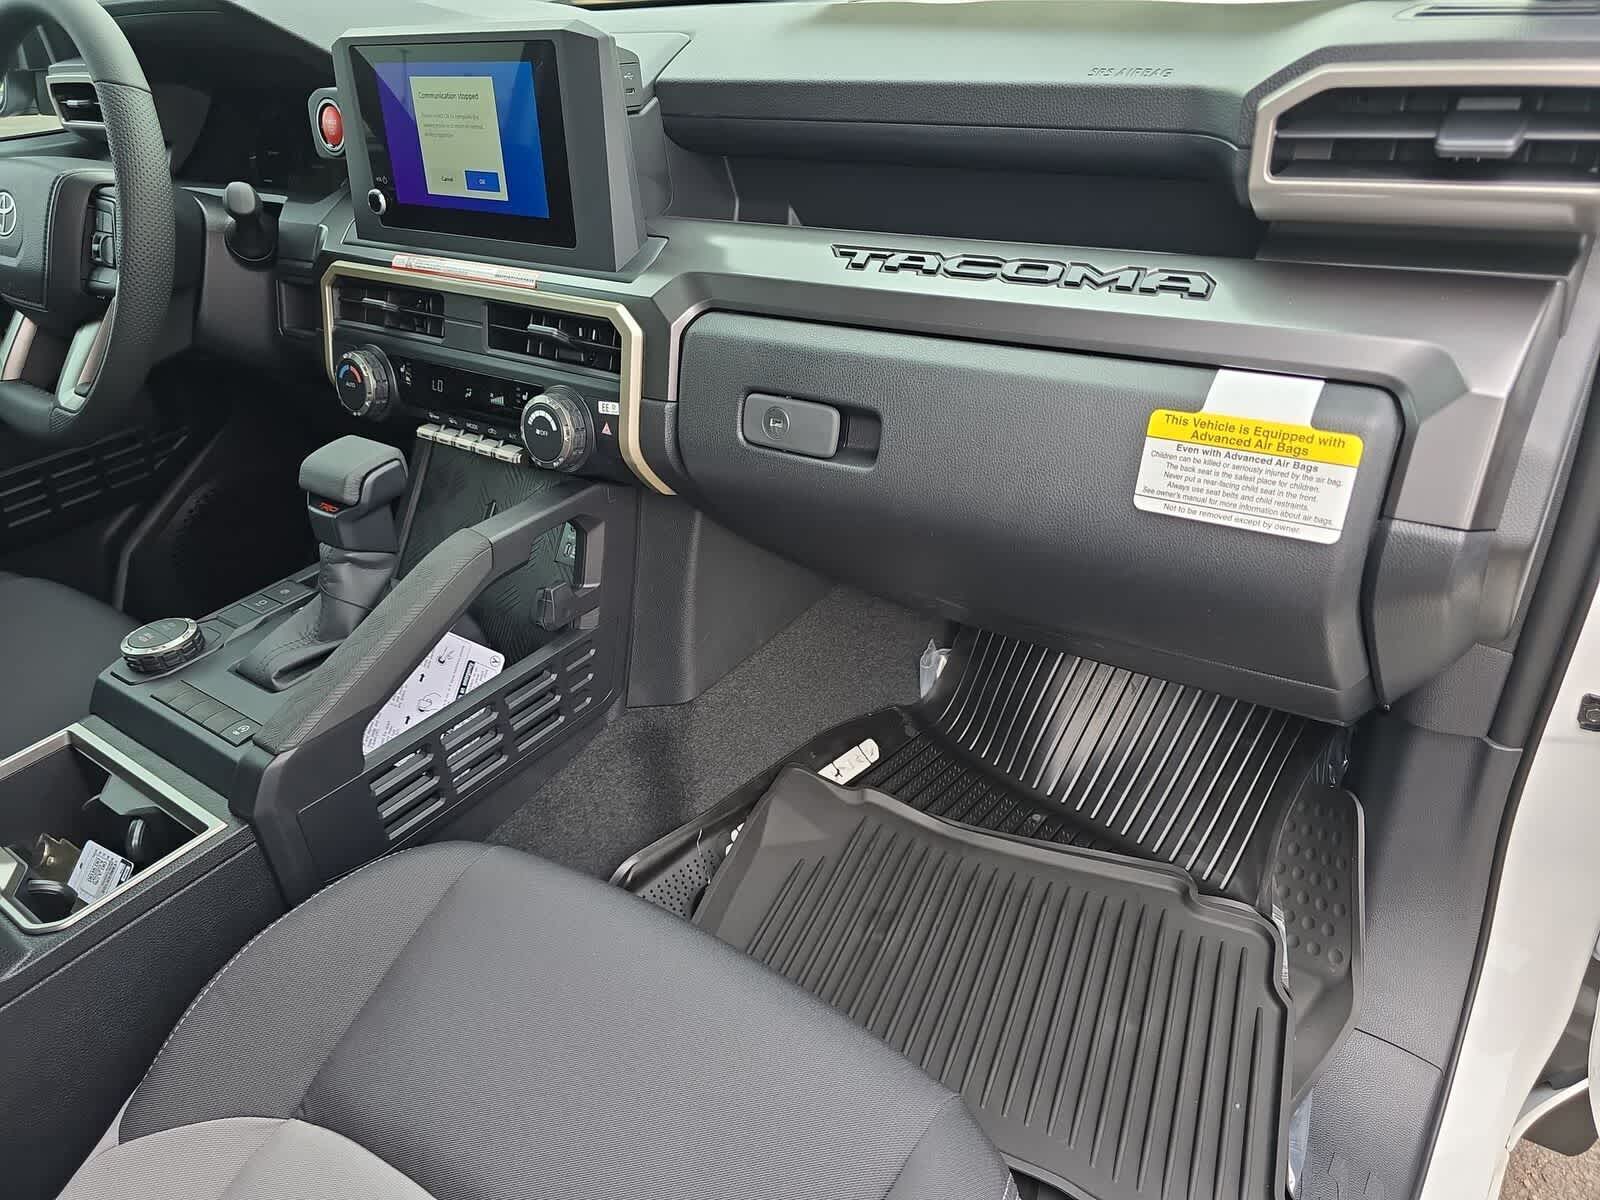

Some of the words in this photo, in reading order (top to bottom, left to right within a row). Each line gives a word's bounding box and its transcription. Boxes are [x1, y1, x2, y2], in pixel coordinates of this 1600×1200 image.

[831, 244, 1217, 301] TACOMA
[1165, 414, 1189, 426] This
[1193, 418, 1236, 432] Vehicle
[1240, 423, 1250, 434] is
[1253, 426, 1315, 444] Equipped
[1318, 436, 1346, 448] with
[1190, 430, 1252, 448] Advanced
[1254, 439, 1272, 450] Air
[1276, 442, 1310, 457] Bags
[1150, 450, 1178, 460] Children
[1203, 458, 1222, 468] killed
[1232, 464, 1264, 474] seriously
[1264, 468, 1290, 478] injured
[1290, 471, 1300, 480] by
[1301, 473, 1314, 481] the
[1176, 444, 1200, 454] Even
[1202, 448, 1222, 458] with
[1223, 450, 1274, 465] Advanced
[1275, 459, 1290, 468] Air
[1292, 461, 1319, 472] Bags
[1164, 472, 1183, 480] Never
[1184, 474, 1196, 483] put
[1202, 478, 1240, 490] rear-facing
[1241, 484, 1258, 493] child
[1260, 487, 1276, 496] seat
[1276, 489, 1284, 497] in
[1285, 490, 1298, 499] the
[1166, 462, 1179, 470] The
[1180, 464, 1196, 472] back
[1198, 468, 1213, 476] seat
[1221, 471, 1232, 479] the
[1234, 474, 1256, 482] safest
[1256, 477, 1278, 486] place
[1278, 480, 1288, 488] for
[1142, 486, 1156, 494] See
[1156, 489, 1181, 499] owner's
[1182, 494, 1208, 504] manual
[1208, 497, 1218, 505] for
[1219, 500, 1238, 509] more
[1238, 502, 1279, 516] information
[1280, 510, 1300, 520] about
[1302, 512, 1312, 521] air
[1166, 481, 1190, 492] Always
[1206, 487, 1221, 496] seat
[1221, 490, 1239, 499] belts
[1240, 494, 1254, 502] and
[1255, 496, 1272, 505] child
[1163, 503, 1177, 512] Not
[1187, 507, 1198, 515] be
[1200, 510, 1233, 522] removed
[1234, 516, 1261, 526] except
[1262, 520, 1272, 528] by
